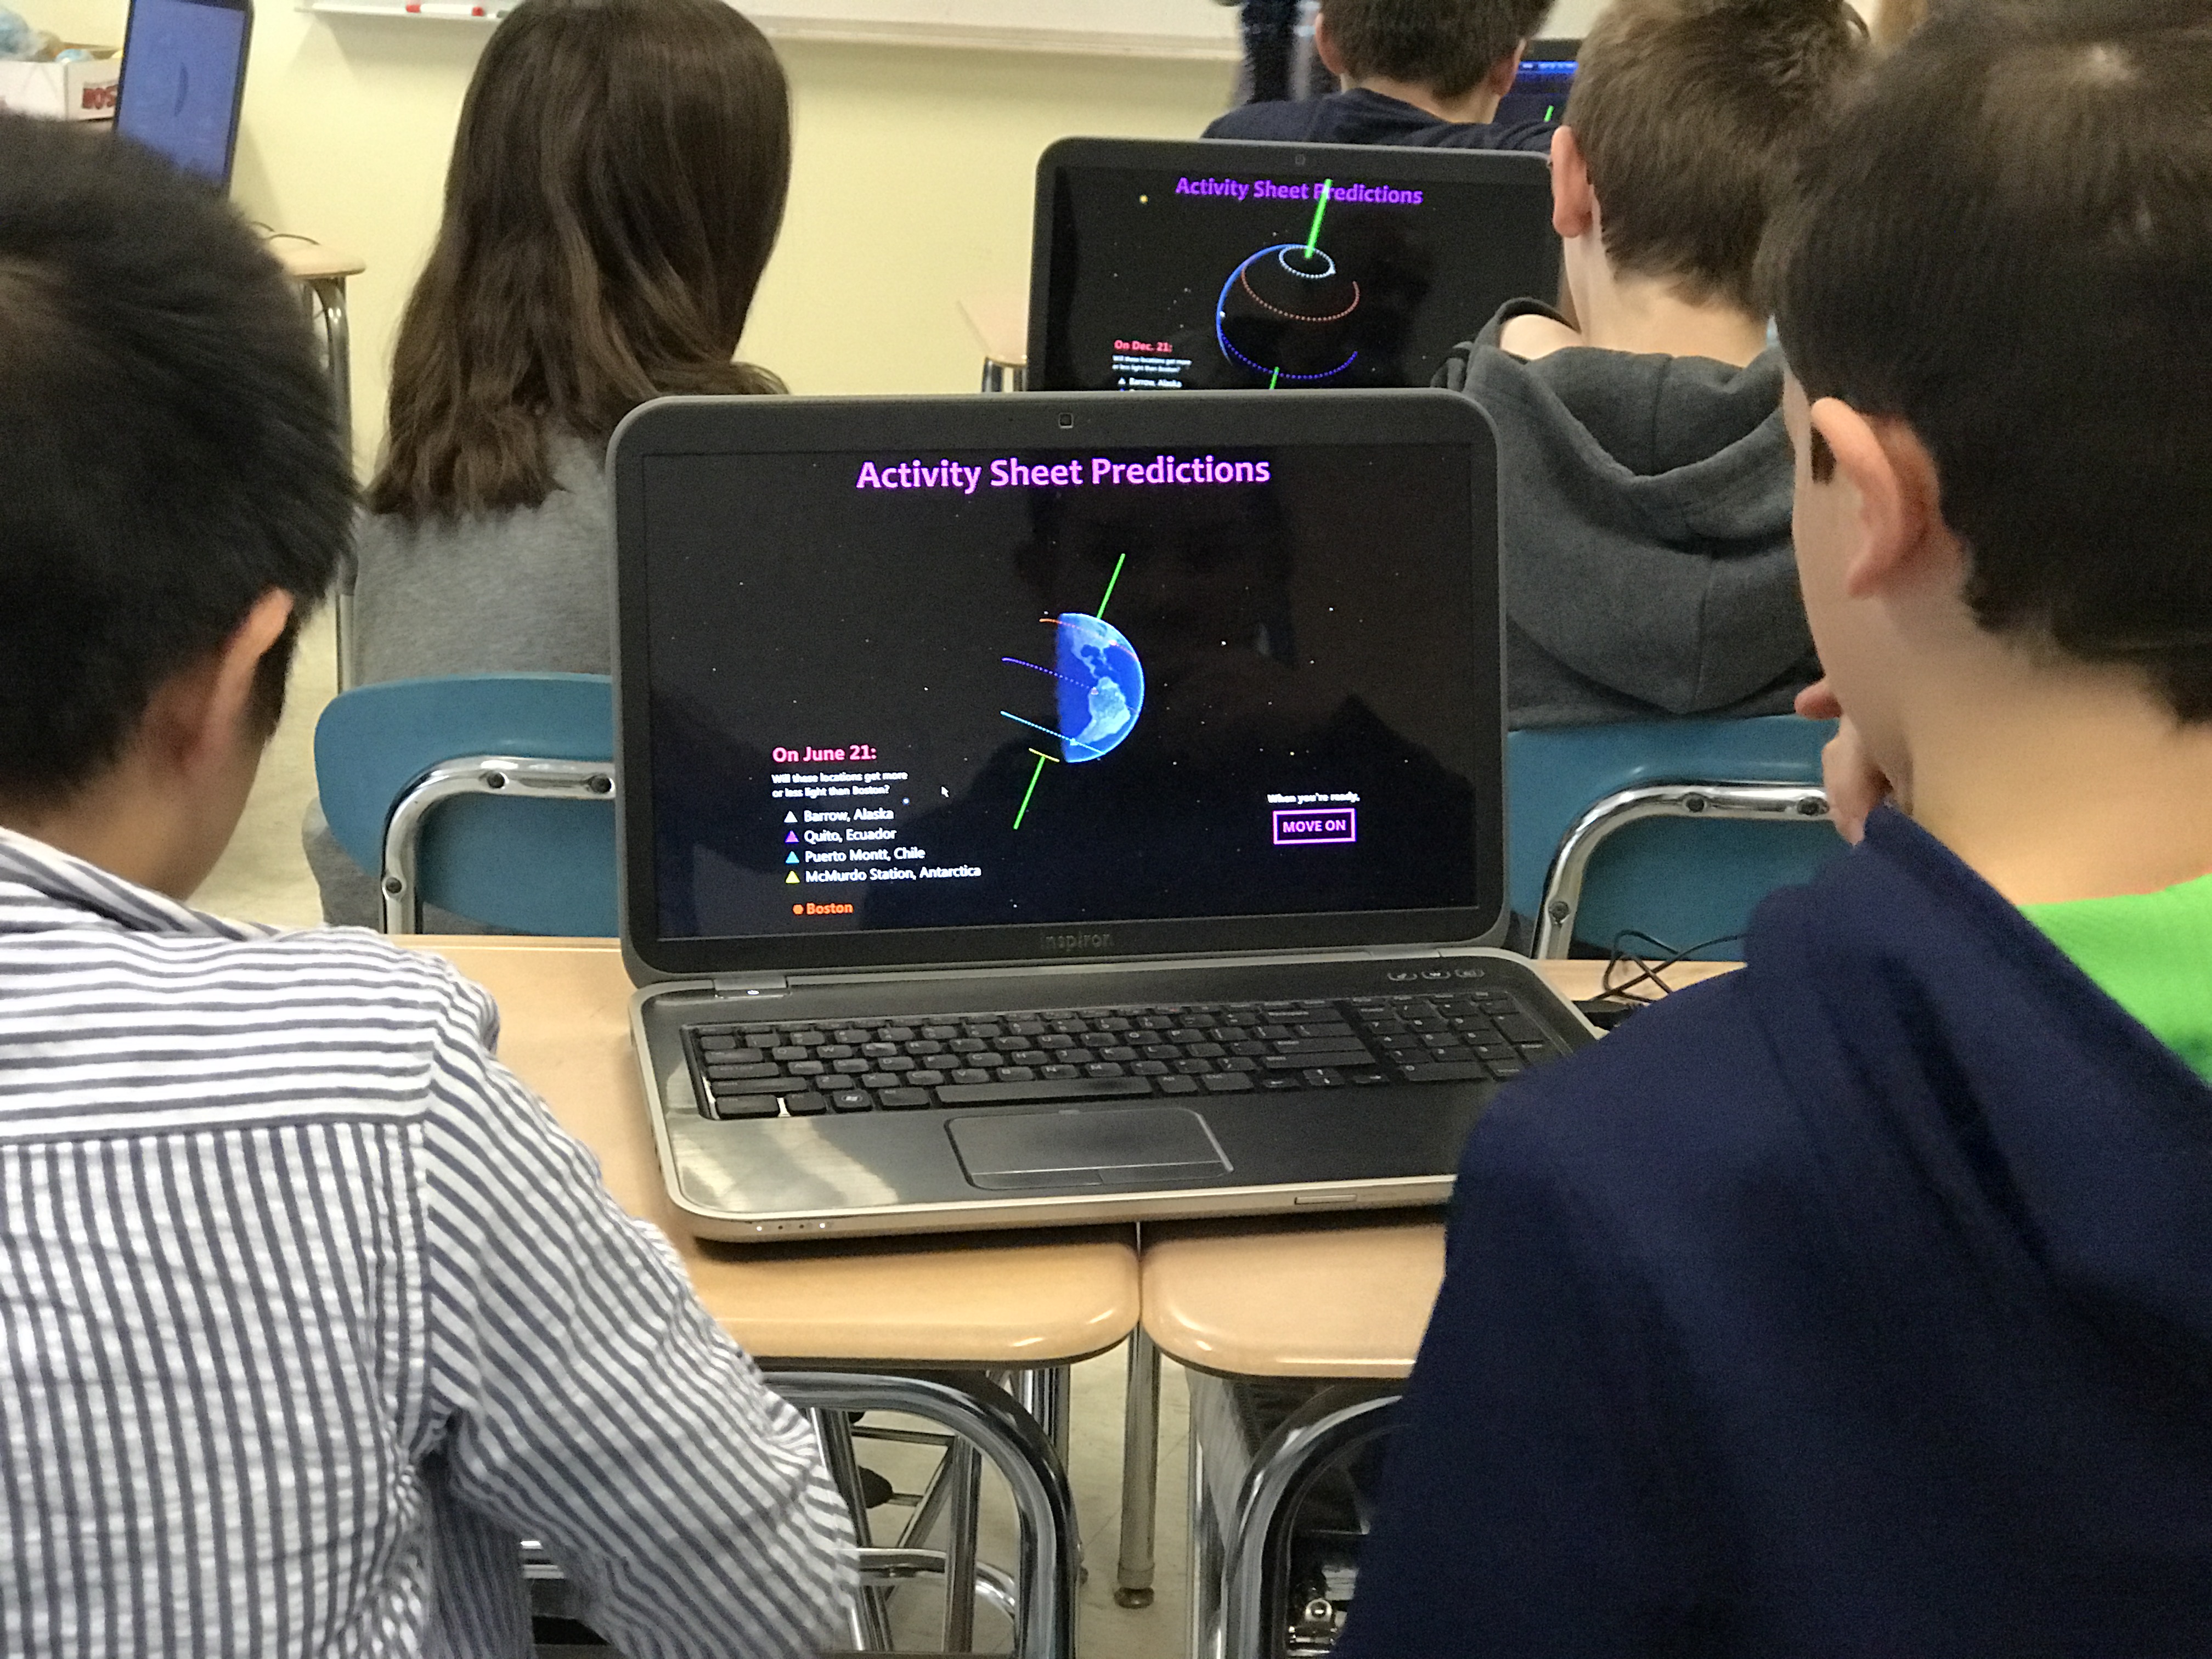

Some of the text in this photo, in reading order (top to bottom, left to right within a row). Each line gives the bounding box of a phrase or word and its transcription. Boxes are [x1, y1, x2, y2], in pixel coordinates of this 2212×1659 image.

[1175, 177, 1250, 201] Activity
[1254, 180, 1310, 199] Sheet
[1114, 340, 1130, 349] On
[856, 455, 1271, 494] Activity Sheet Predictions
[772, 745, 877, 763] On June 21:
[771, 774, 791, 783] Will
[792, 774, 819, 783] these
[820, 772, 862, 782] locations
[785, 788, 803, 797] less
[805, 787, 827, 799] light
[828, 787, 850, 795] than
[853, 784, 890, 795] Boston?
[804, 808, 894, 822] Barrow, Alaska
[1283, 820, 1346, 833] MOVE ON
[804, 827, 897, 844] Quito, Ecuador
[805, 847, 926, 862] Puerto Montt, Chile
[806, 865, 981, 882] McMurdo Station, Antarctica
[806, 903, 853, 915] Boston
